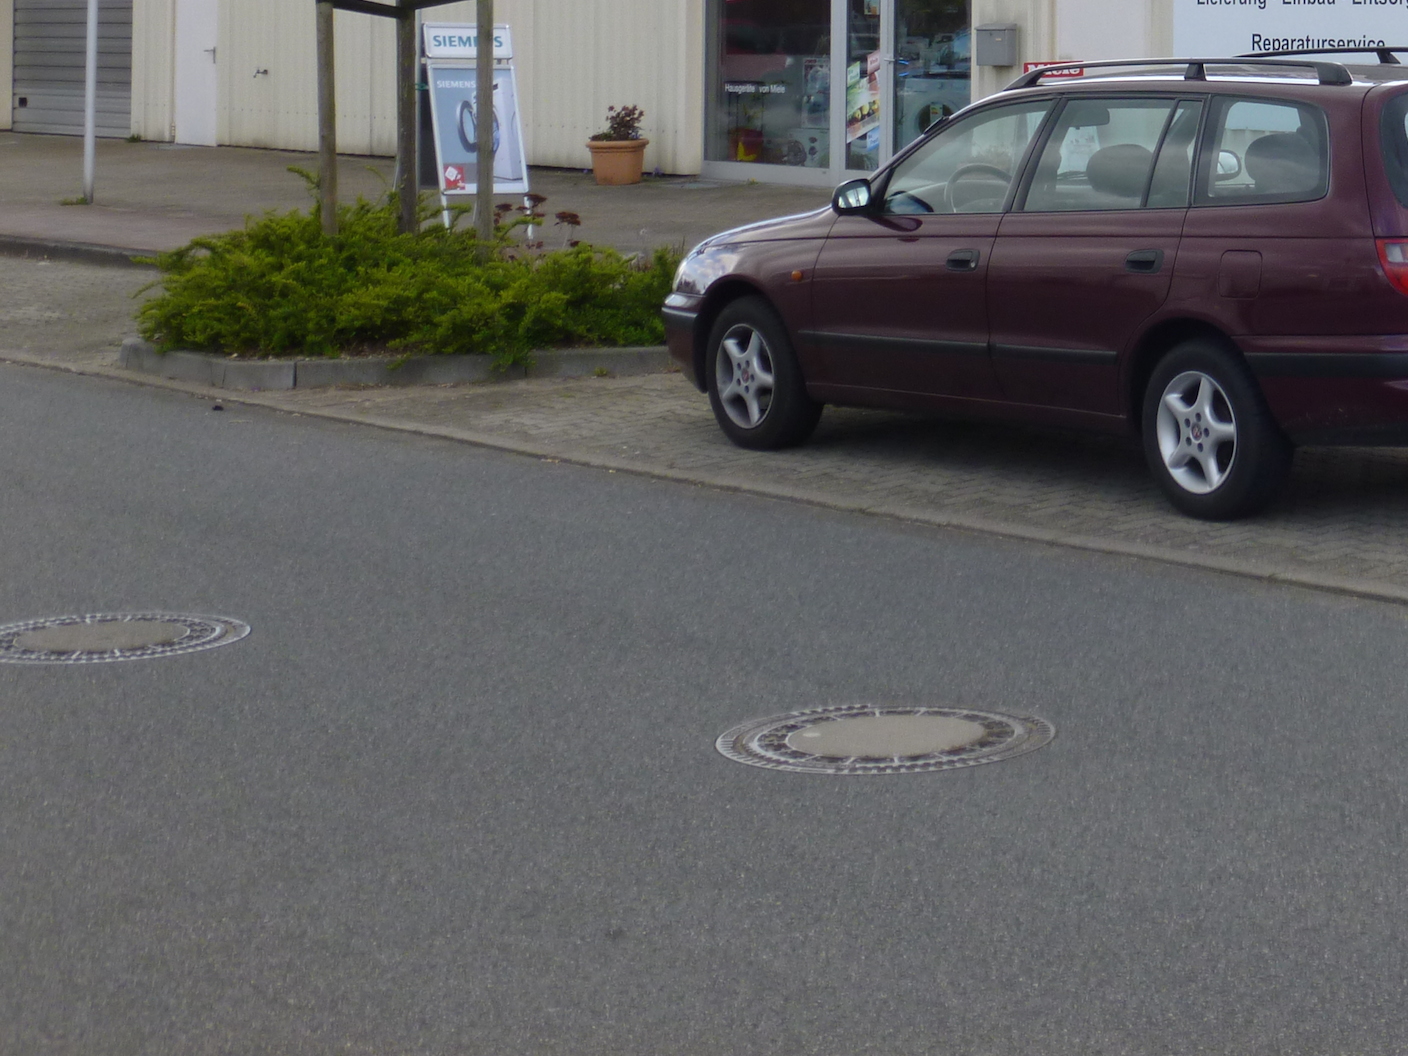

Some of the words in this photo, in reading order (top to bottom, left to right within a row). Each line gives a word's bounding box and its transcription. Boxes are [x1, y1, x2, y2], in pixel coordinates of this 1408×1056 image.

[432, 35, 504, 48] SIEMS
[1251, 33, 1386, 51] Reparaturservice
[436, 80, 476, 89] SIEMENS
[724, 84, 756, 94] Hausgeräte
[770, 85, 786, 94] Miele
